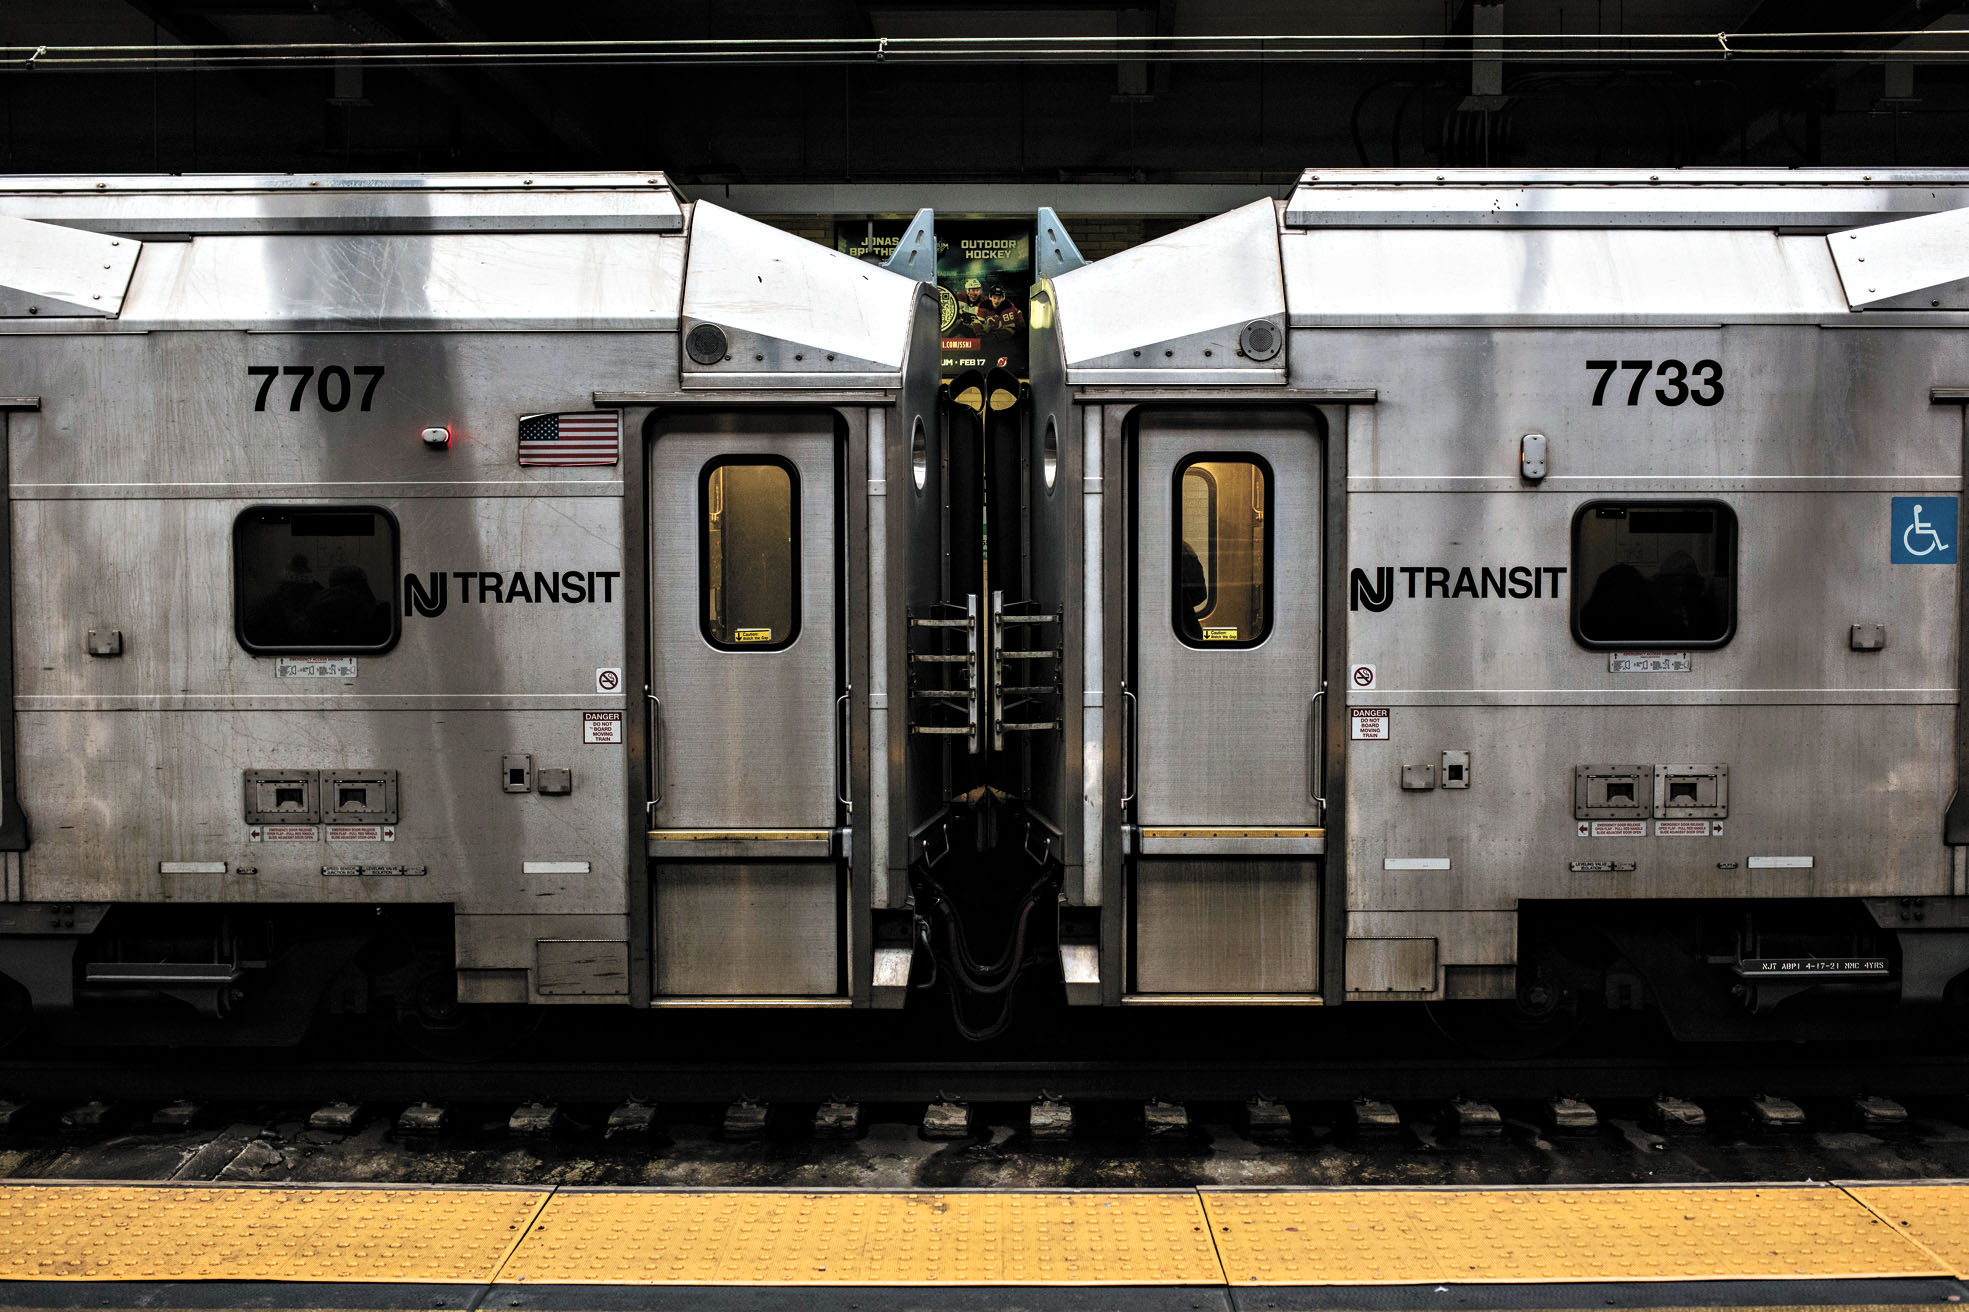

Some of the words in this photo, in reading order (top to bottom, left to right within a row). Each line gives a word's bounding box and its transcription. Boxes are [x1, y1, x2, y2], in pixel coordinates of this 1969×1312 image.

[961, 240, 1016, 249] OUTDOOR
[966, 250, 1011, 259] HOCKEY
[247, 365, 385, 412] 7707
[1586, 359, 1724, 406] 7733
[404, 572, 447, 618] NJ
[453, 570, 620, 604] TRANSIT
[1350, 567, 1394, 613] NJ
[1400, 566, 1567, 599] TRANSIT
